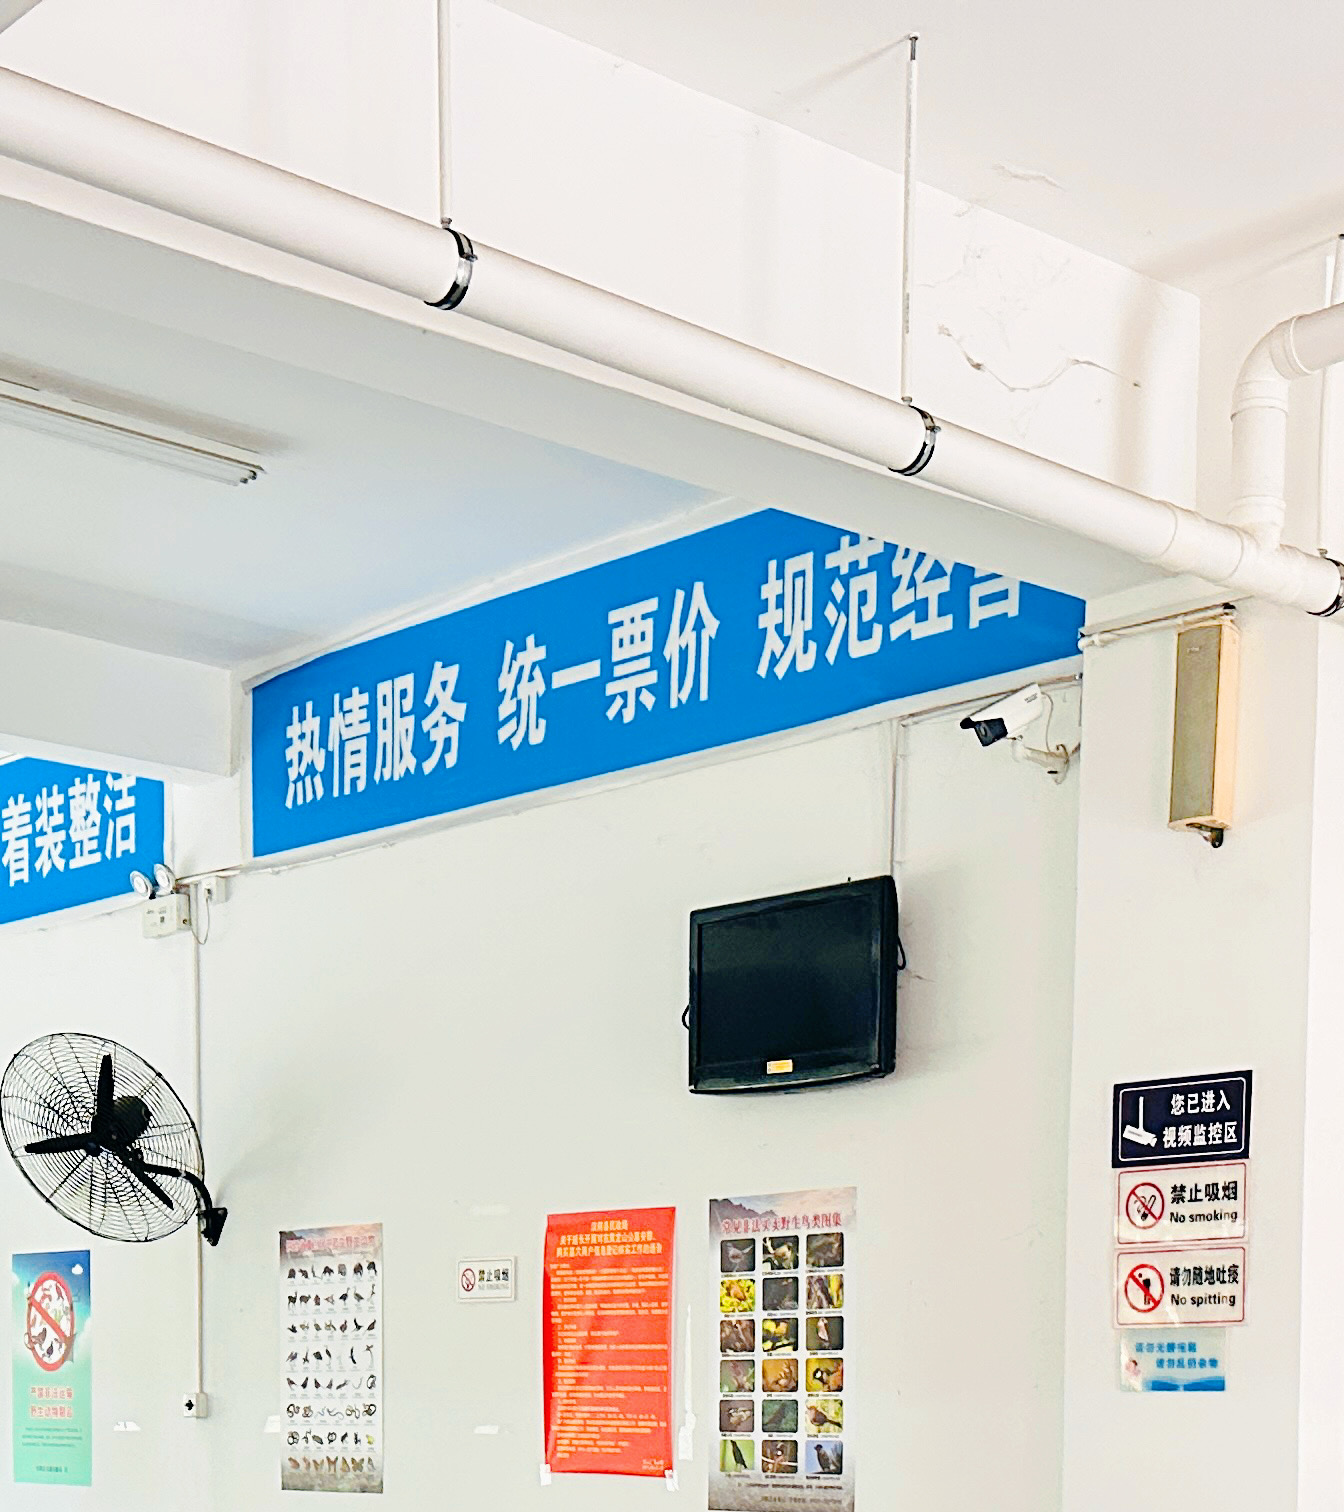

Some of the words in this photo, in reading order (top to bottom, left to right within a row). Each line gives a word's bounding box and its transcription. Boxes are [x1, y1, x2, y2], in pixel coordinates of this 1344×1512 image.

[284, 660, 467, 810] 热情服务
[497, 580, 721, 752] 统一票价
[1, 773, 137, 887] 着装整洁
[1170, 1089, 1231, 1115] 您已进入
[1162, 1121, 1238, 1149] 视频监控区
[1170, 1180, 1238, 1205] 禁止吸烟
[1170, 1211, 1186, 1223] No
[1188, 1210, 1238, 1224] smoking
[1169, 1265, 1239, 1287] 请勿随地吐痰
[1171, 1294, 1187, 1306] No
[1190, 1292, 1236, 1307] spitting
